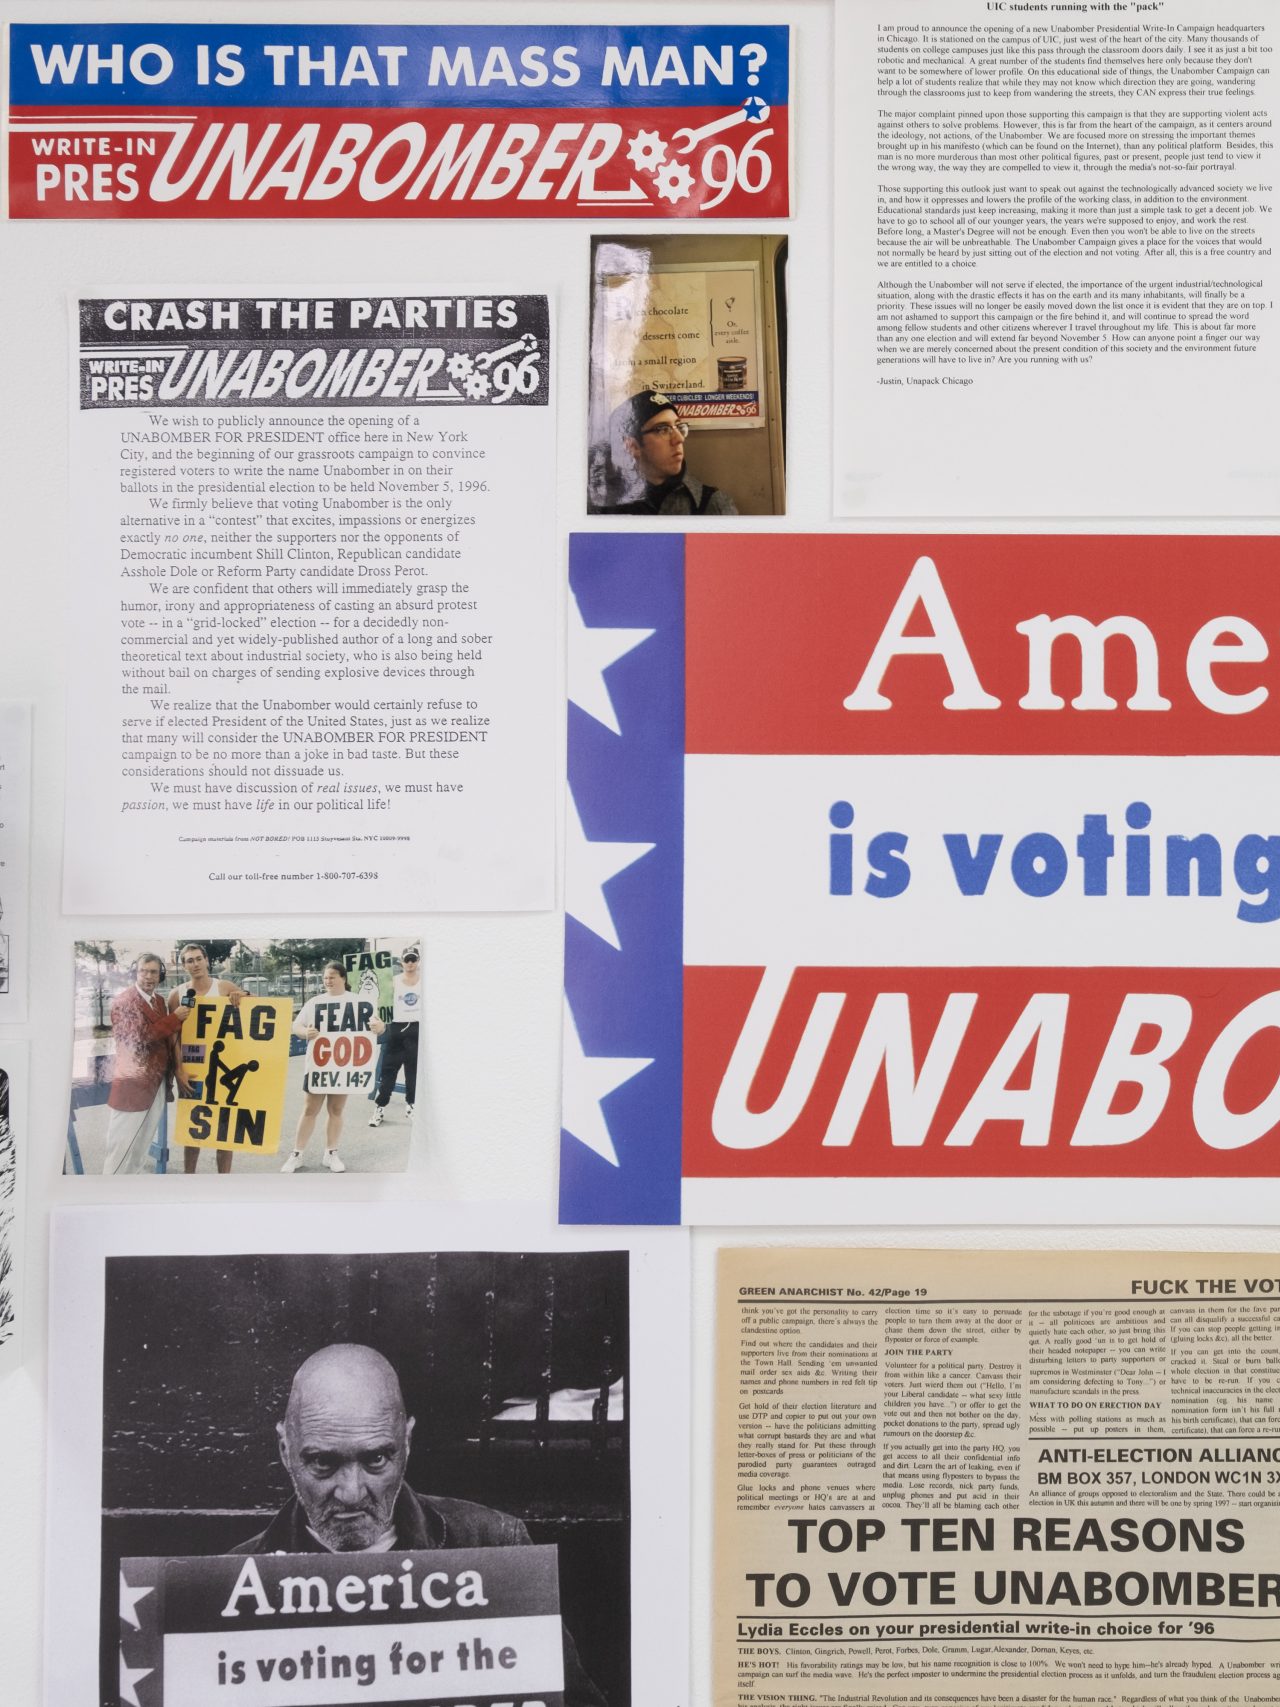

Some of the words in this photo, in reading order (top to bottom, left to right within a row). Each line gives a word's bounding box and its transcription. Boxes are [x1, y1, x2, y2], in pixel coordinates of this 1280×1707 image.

[987, 2, 1006, 11] UIC
[1009, 2, 1048, 11] students
[1051, 2, 1088, 12] running
[1090, 2, 1110, 11] with
[1113, 2, 1128, 11] the
[1131, 2, 1164, 13] "pack"
[30, 43, 174, 85] WHO
[197, 44, 246, 87] IS
[263, 45, 408, 86] THAT
[428, 46, 581, 87] MASS
[602, 43, 767, 86] MAN?
[31, 137, 156, 156] WRITE-IN
[149, 121, 648, 202] UNABOMBER
[700, 128, 774, 210] 96
[36, 163, 140, 202] PRES
[103, 299, 240, 331] CRASH
[255, 299, 335, 329] THE
[349, 299, 519, 330] PARTIES
[648, 307, 689, 316] chocolate
[642, 332, 676, 341] desserts
[88, 360, 165, 374] WRITE-IN
[158, 347, 450, 400] UNABOMBER
[491, 353, 541, 404] 96
[91, 376, 154, 402] PRES
[829, 801, 911, 898] is
[345, 951, 392, 971] FAG
[196, 1003, 276, 1041] FAG
[314, 1002, 374, 1032] FEAR
[313, 1036, 373, 1067] GOD
[311, 1071, 341, 1088] REV.
[345, 1071, 372, 1088] 14:7
[189, 1105, 266, 1146] SIN
[739, 1287, 775, 1295] GREEN
[779, 1288, 843, 1296] ANARCHIST
[869, 1288, 910, 1298] 42/Page
[915, 1288, 927, 1296] 19
[1132, 1280, 1188, 1294] FUCK
[1196, 1279, 1236, 1293] THE
[1038, 1448, 1192, 1463] ANTI-ELECTION
[1038, 1472, 1061, 1484] BM
[1068, 1472, 1101, 1484] BOX
[1107, 1472, 1136, 1486] 357,
[1142, 1471, 1210, 1484] LONDON
[1215, 1471, 1261, 1484] WC1N
[788, 1519, 885, 1553] TOP
[901, 1518, 994, 1552] TEN
[1014, 1518, 1244, 1553] REASONS
[221, 1556, 488, 1617] America
[746, 1573, 810, 1608] TO
[828, 1571, 955, 1606] VOTE
[738, 1623, 783, 1637] Lydia
[789, 1623, 843, 1636] Eccles
[849, 1623, 869, 1636] on
[876, 1623, 914, 1637] your
[919, 1621, 1019, 1637] presidential
[1026, 1621, 1091, 1635] write-in
[1097, 1621, 1152, 1635] choice
[1158, 1621, 1182, 1635] for
[1189, 1621, 1215, 1635] '96
[217, 1651, 245, 1686] is
[256, 1644, 377, 1687] voting
[389, 1641, 444, 1675] for
[456, 1638, 518, 1671] the
